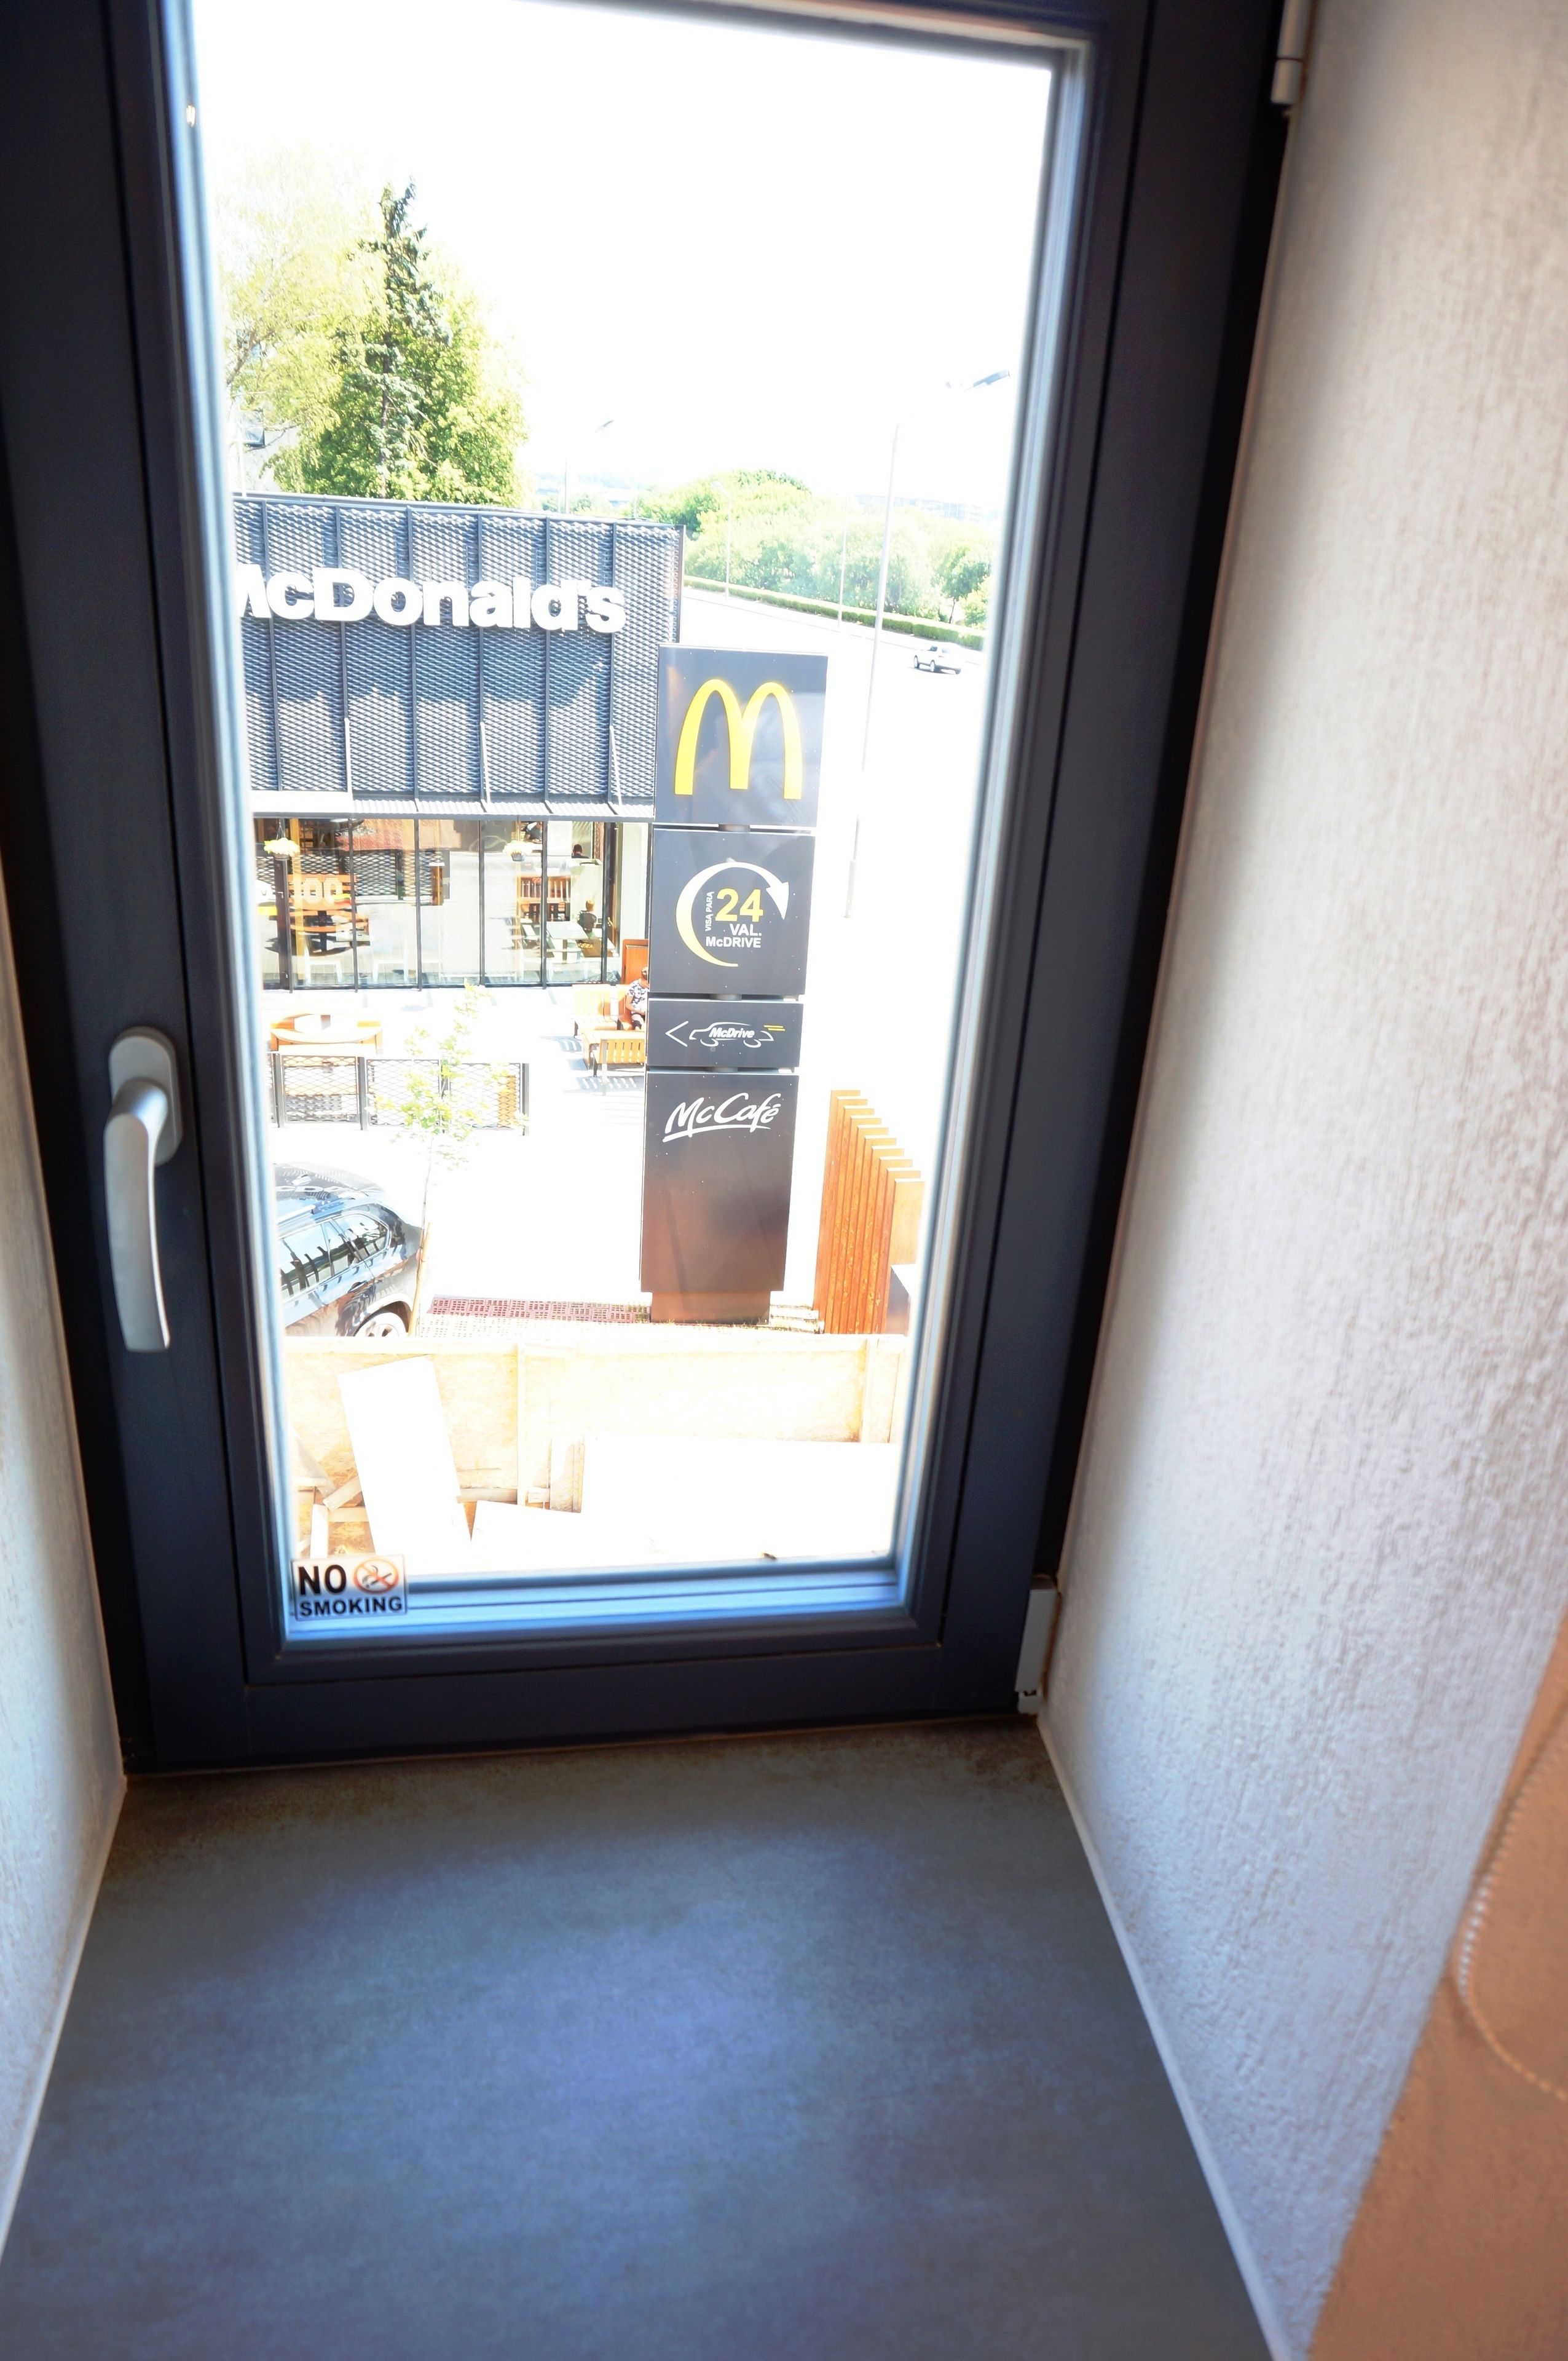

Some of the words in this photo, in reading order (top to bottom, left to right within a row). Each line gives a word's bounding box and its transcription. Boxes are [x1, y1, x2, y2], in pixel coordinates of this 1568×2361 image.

[715, 888, 763, 922] 24
[729, 923, 762, 936] VAL.
[706, 936, 762, 948] McDRIVE
[709, 1027, 755, 1038] McDrive
[663, 1092, 781, 1139] McCafé
[298, 1564, 347, 1595] NO
[300, 1597, 403, 1617] SMOKING
